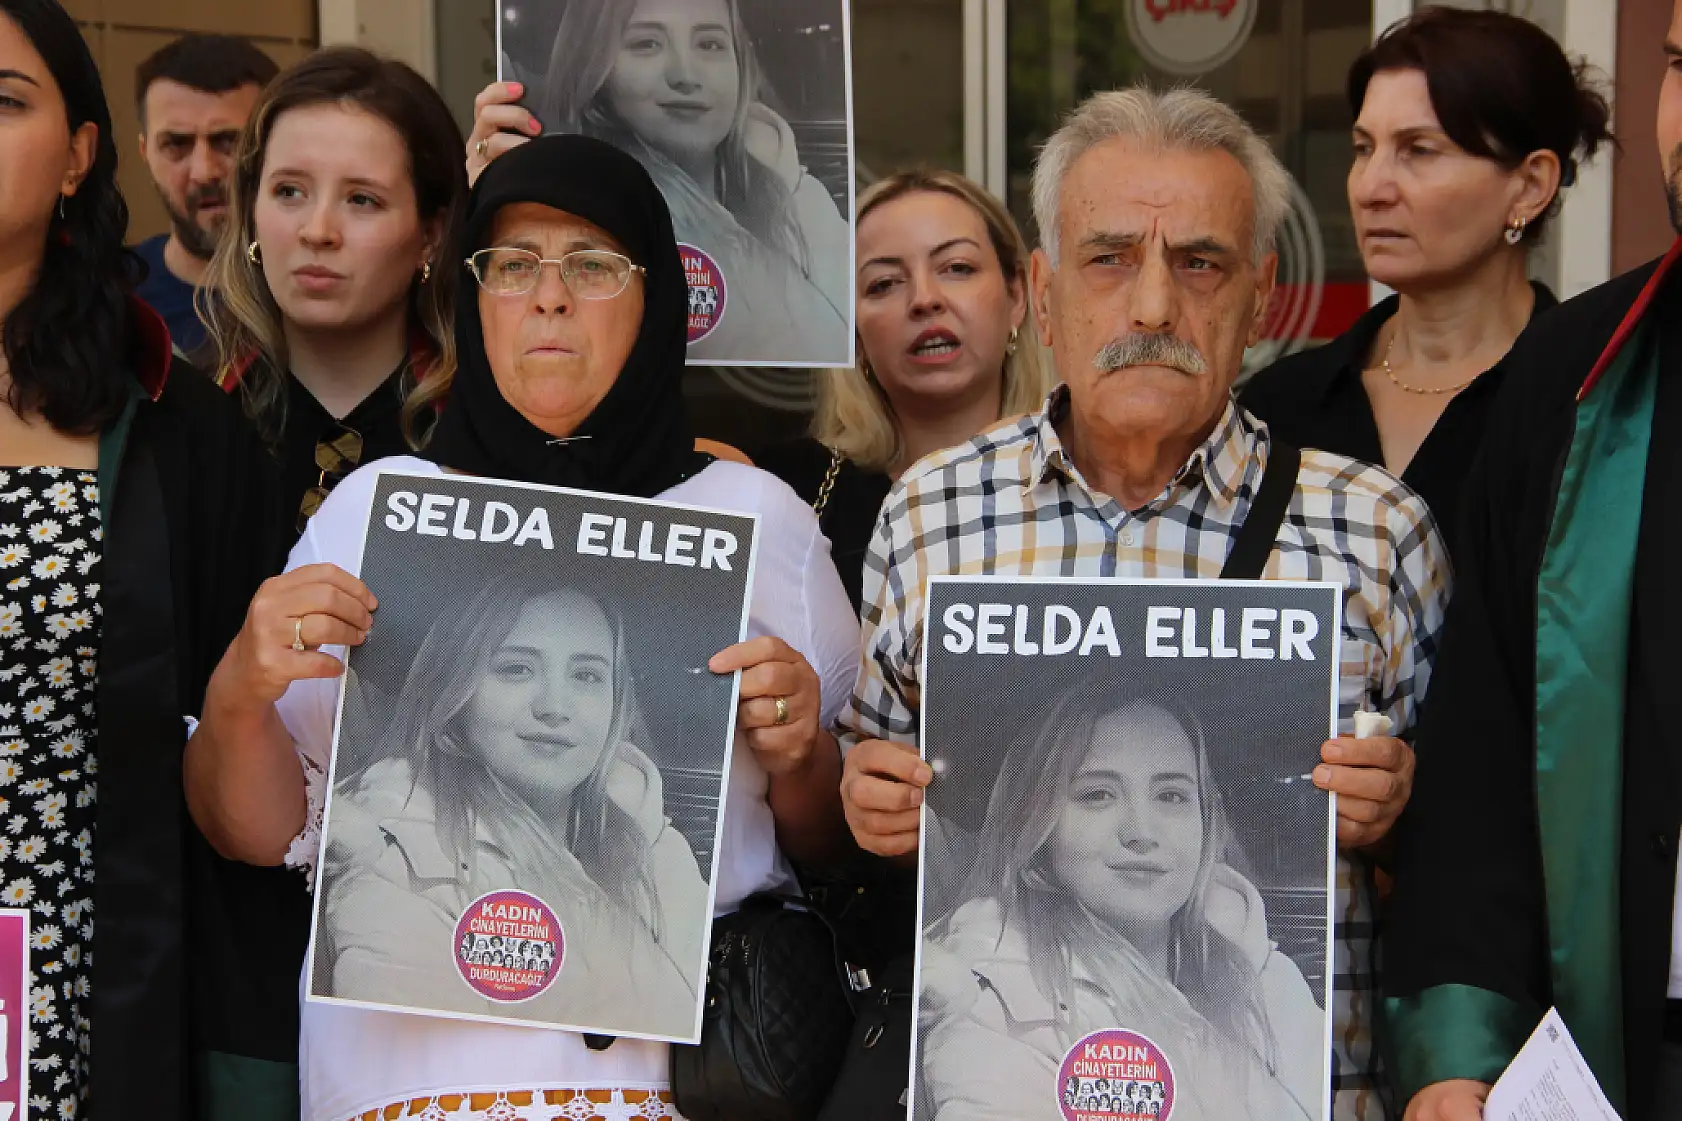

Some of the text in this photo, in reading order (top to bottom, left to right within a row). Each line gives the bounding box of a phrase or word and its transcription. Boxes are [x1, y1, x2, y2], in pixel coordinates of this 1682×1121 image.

[385, 491, 738, 571] SELDA ELLER
[943, 603, 1319, 660] SELDA ELLER
[481, 902, 541, 922] KADIN
[470, 917, 549, 939] CİNAYETLERİNİ
[1084, 1043, 1147, 1062] KADIN
[1073, 1059, 1156, 1079] CİNAYETLERİNİ
